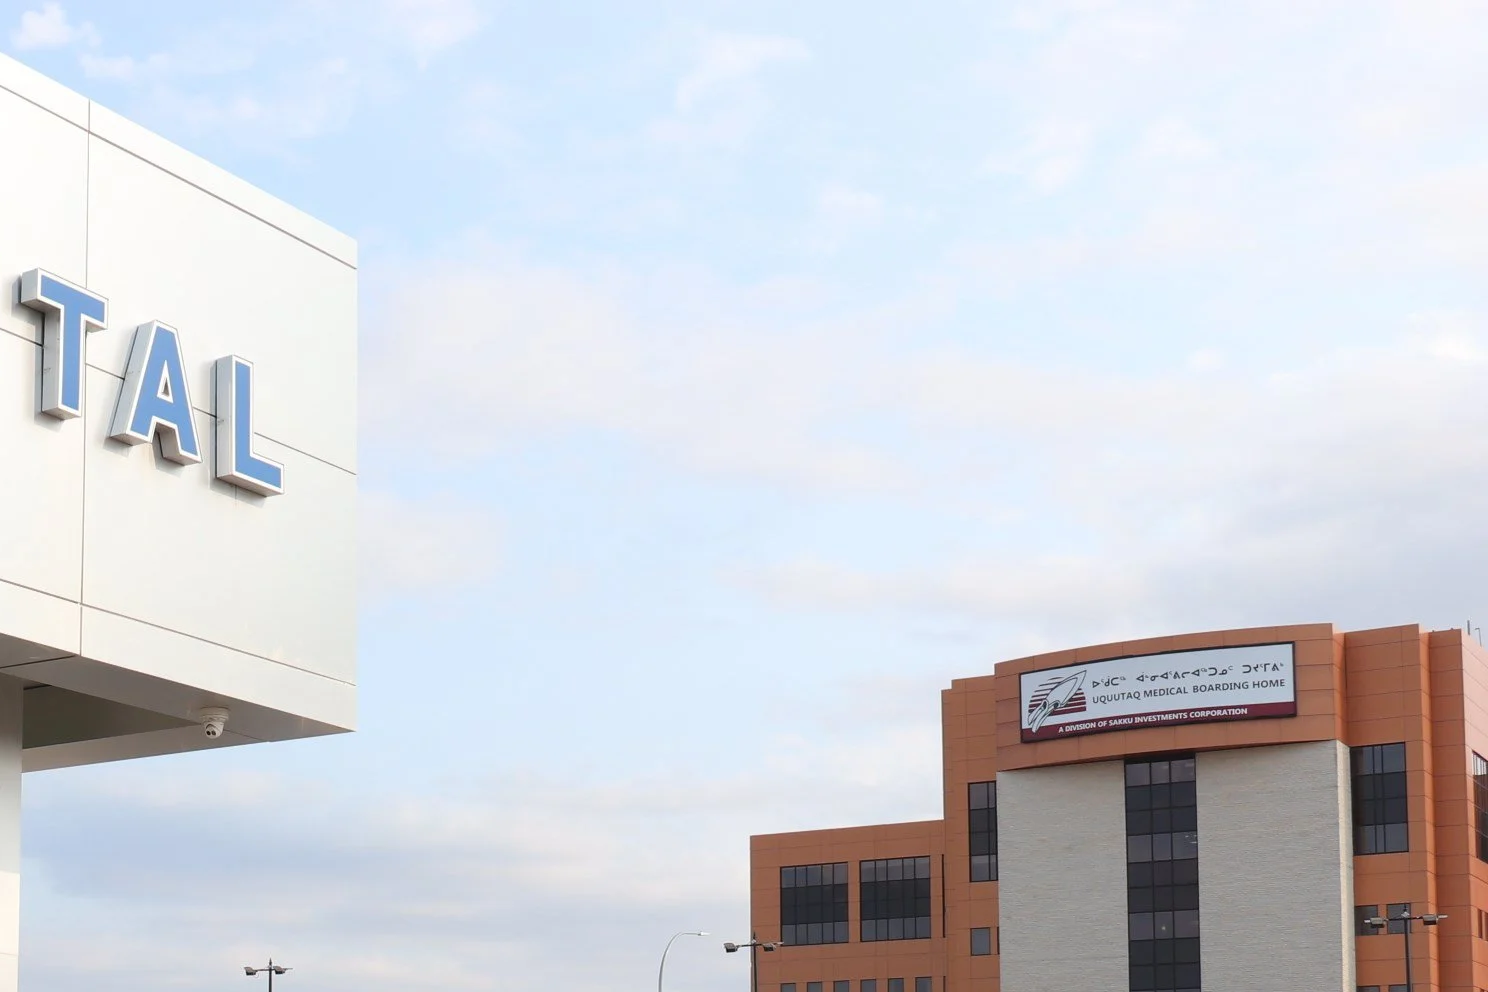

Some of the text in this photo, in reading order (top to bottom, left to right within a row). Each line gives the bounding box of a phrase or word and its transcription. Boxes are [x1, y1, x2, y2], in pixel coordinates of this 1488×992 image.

[1092, 679, 1286, 704] UQUUTAQ MEDICAL BOARDING HOME
[1065, 722, 1096, 732] DIVISION
[1098, 720, 1107, 728] OF
[1109, 717, 1133, 726] SAKKU
[1135, 712, 1188, 723] INVESTMENTS
[1189, 708, 1248, 718] CORPORATION
